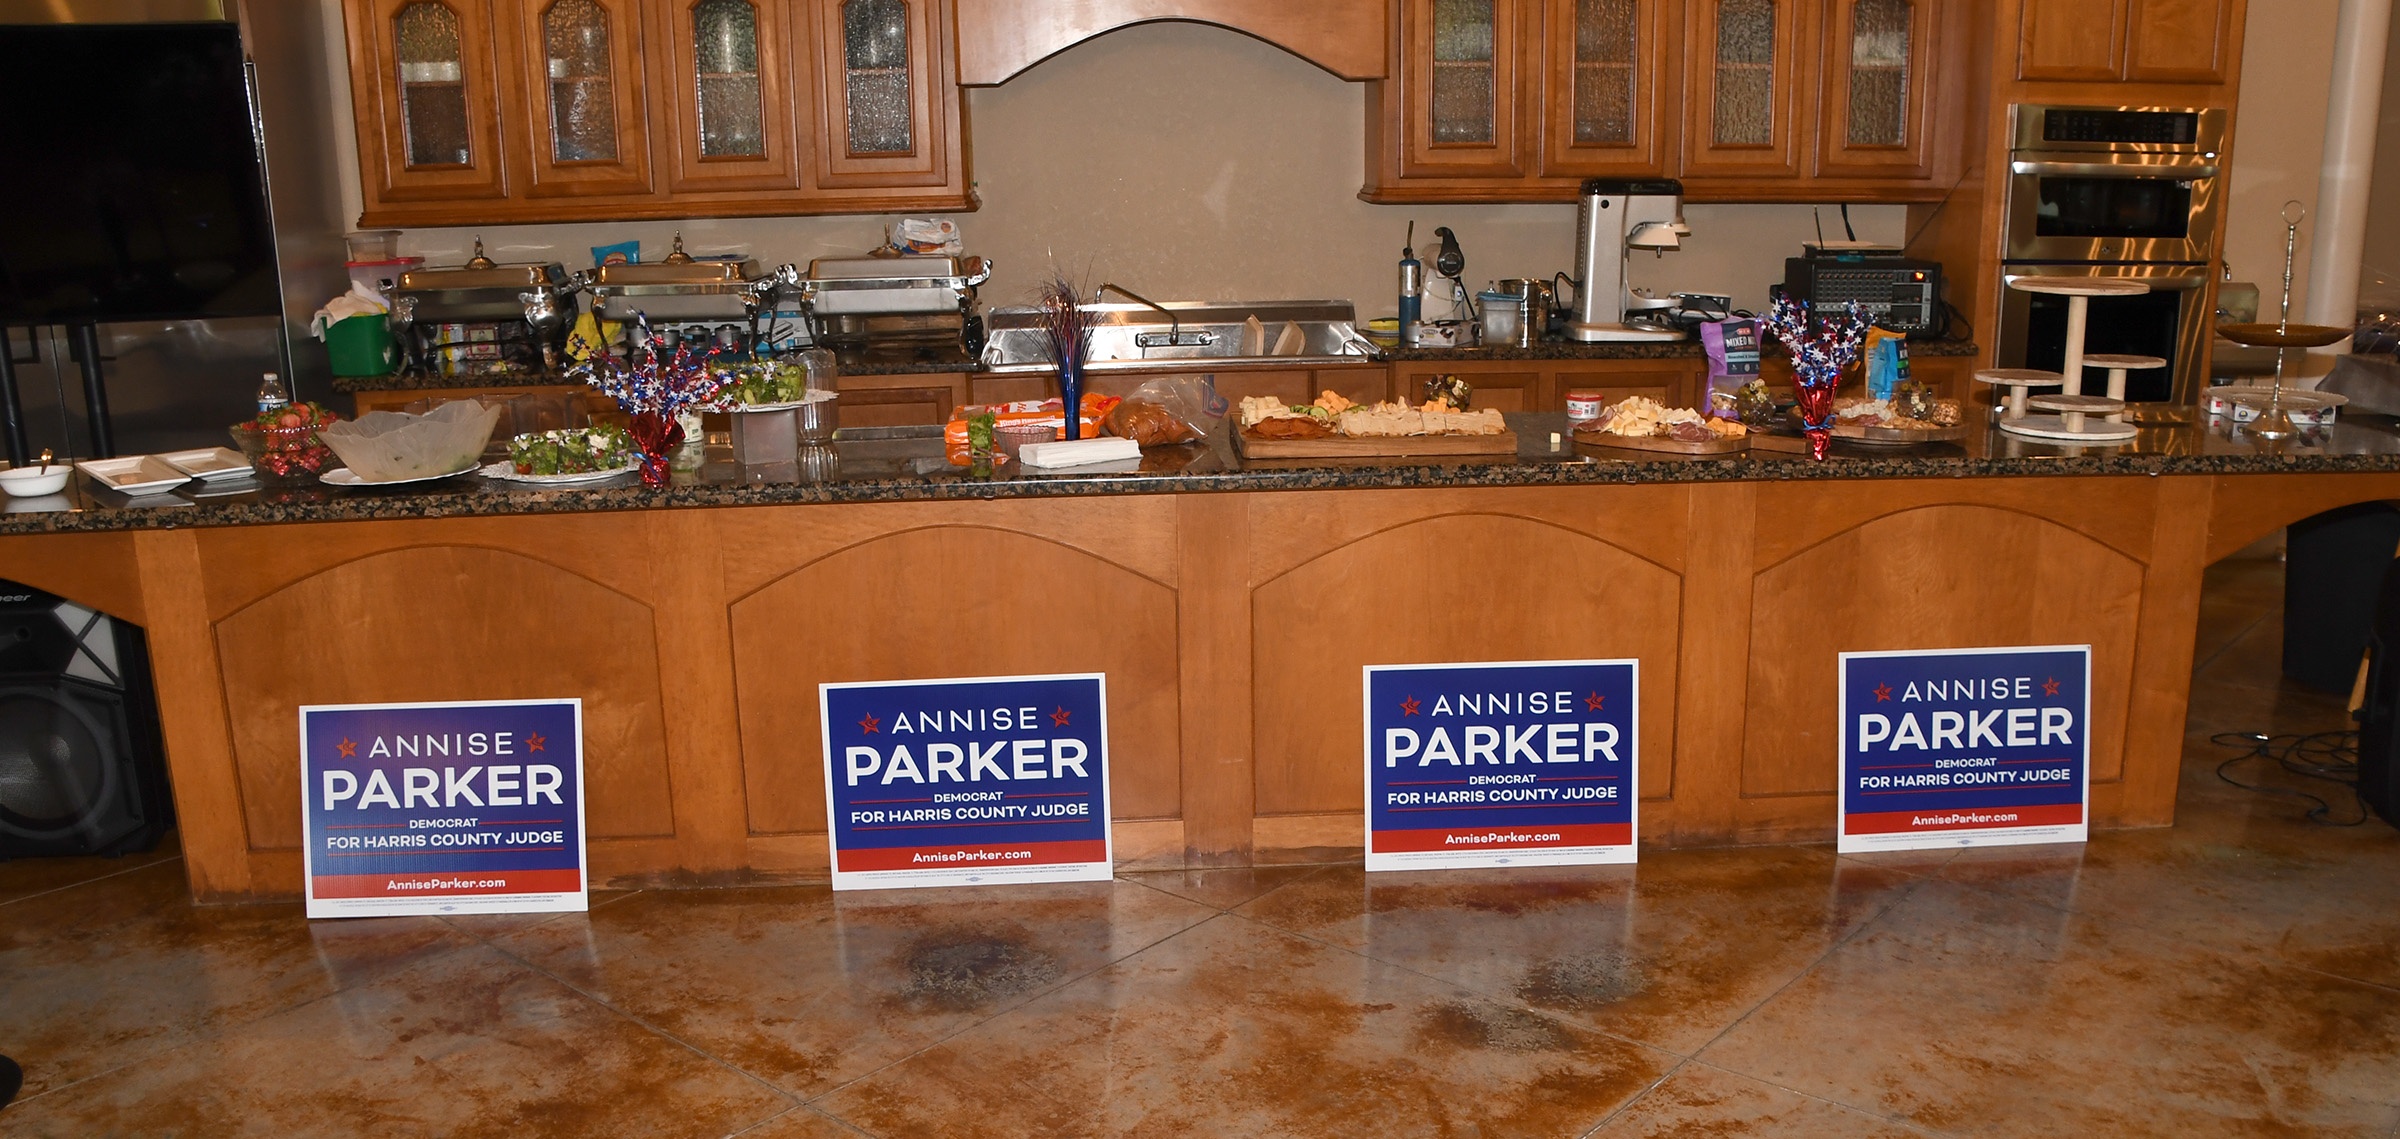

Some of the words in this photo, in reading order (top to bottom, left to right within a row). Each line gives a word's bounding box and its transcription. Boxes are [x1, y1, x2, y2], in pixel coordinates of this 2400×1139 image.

[1725, 336, 1748, 348] MIXED
[1901, 677, 2032, 703] ANNISE
[1431, 691, 1573, 717] ANNISE
[891, 706, 1039, 735] ANNISE
[1858, 707, 2073, 753] PARKER
[368, 731, 514, 759] ANNISE
[1385, 722, 1620, 768] PARKER
[845, 738, 1089, 787] PARKER
[1935, 757, 1998, 769] DEMOCRAT
[322, 764, 564, 811] PARKER
[1469, 773, 1537, 786] DEMOCRAT
[1859, 776, 1891, 789] FOR
[1893, 773, 1951, 788] HARRIS
[1953, 770, 2018, 785] COUNTY
[2019, 768, 2071, 782] JUDGE
[933, 791, 1004, 803] DEMOCRAT
[1387, 792, 1421, 805] FOR
[1424, 790, 1486, 804] HARRIS
[1488, 787, 1559, 802] COUNTY
[1561, 786, 1618, 800] JUDGE
[851, 810, 885, 824] FOR
[888, 808, 952, 823] HARRIS
[955, 805, 1028, 820] COUNTY
[1030, 802, 1089, 817] JUDGE
[1911, 812, 2018, 826] AnniseParker.com
[409, 817, 479, 830] DEMOCRAT
[327, 836, 361, 849] FOR
[363, 834, 427, 850] HARRIS
[429, 832, 503, 847] COUNTY
[505, 830, 564, 845] JUDGE
[1444, 831, 1561, 845] AnniseParker.com
[912, 849, 1032, 863] AnniseParker.com
[386, 877, 506, 891] AnniseParker.com
